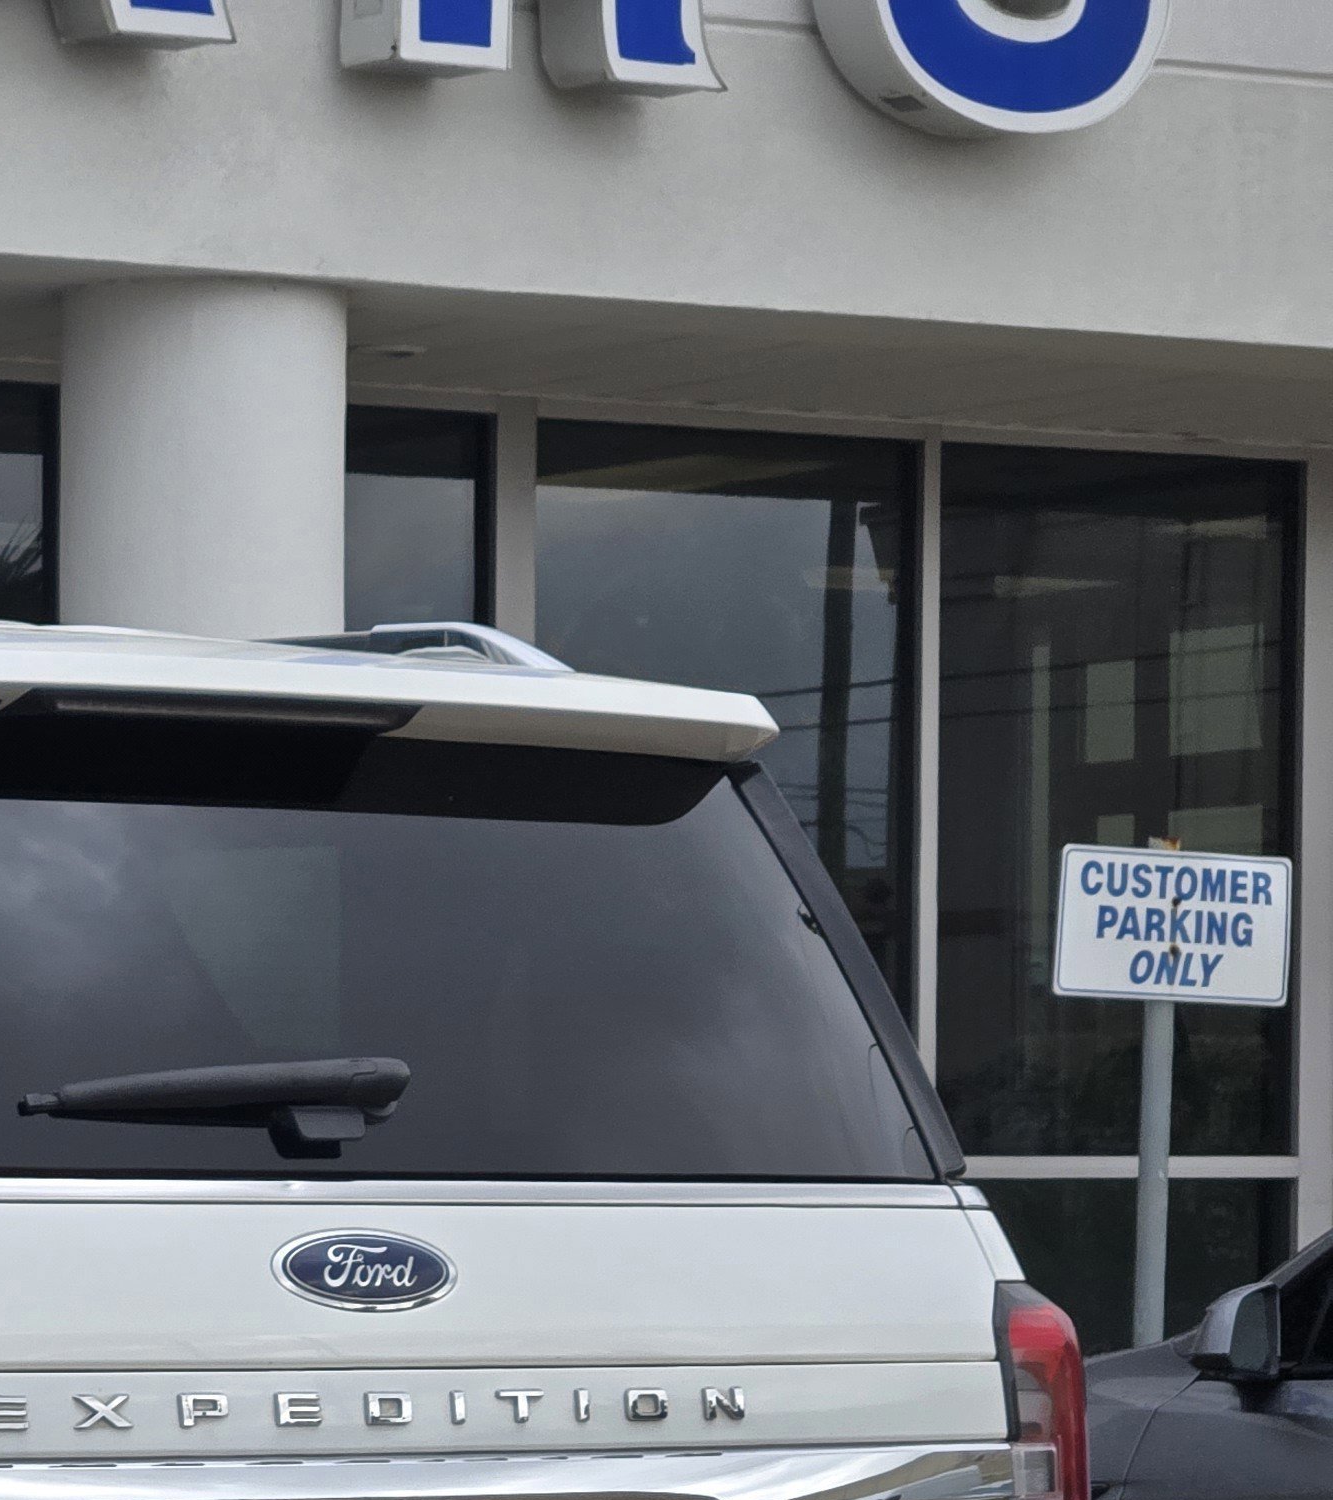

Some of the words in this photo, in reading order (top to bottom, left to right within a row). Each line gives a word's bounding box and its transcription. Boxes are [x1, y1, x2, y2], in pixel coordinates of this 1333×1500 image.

[1081, 860, 1272, 905] CUSTOMER
[1096, 905, 1254, 947] PARKING
[1129, 950, 1224, 987] ONLY
[322, 1243, 417, 1290] Ford
